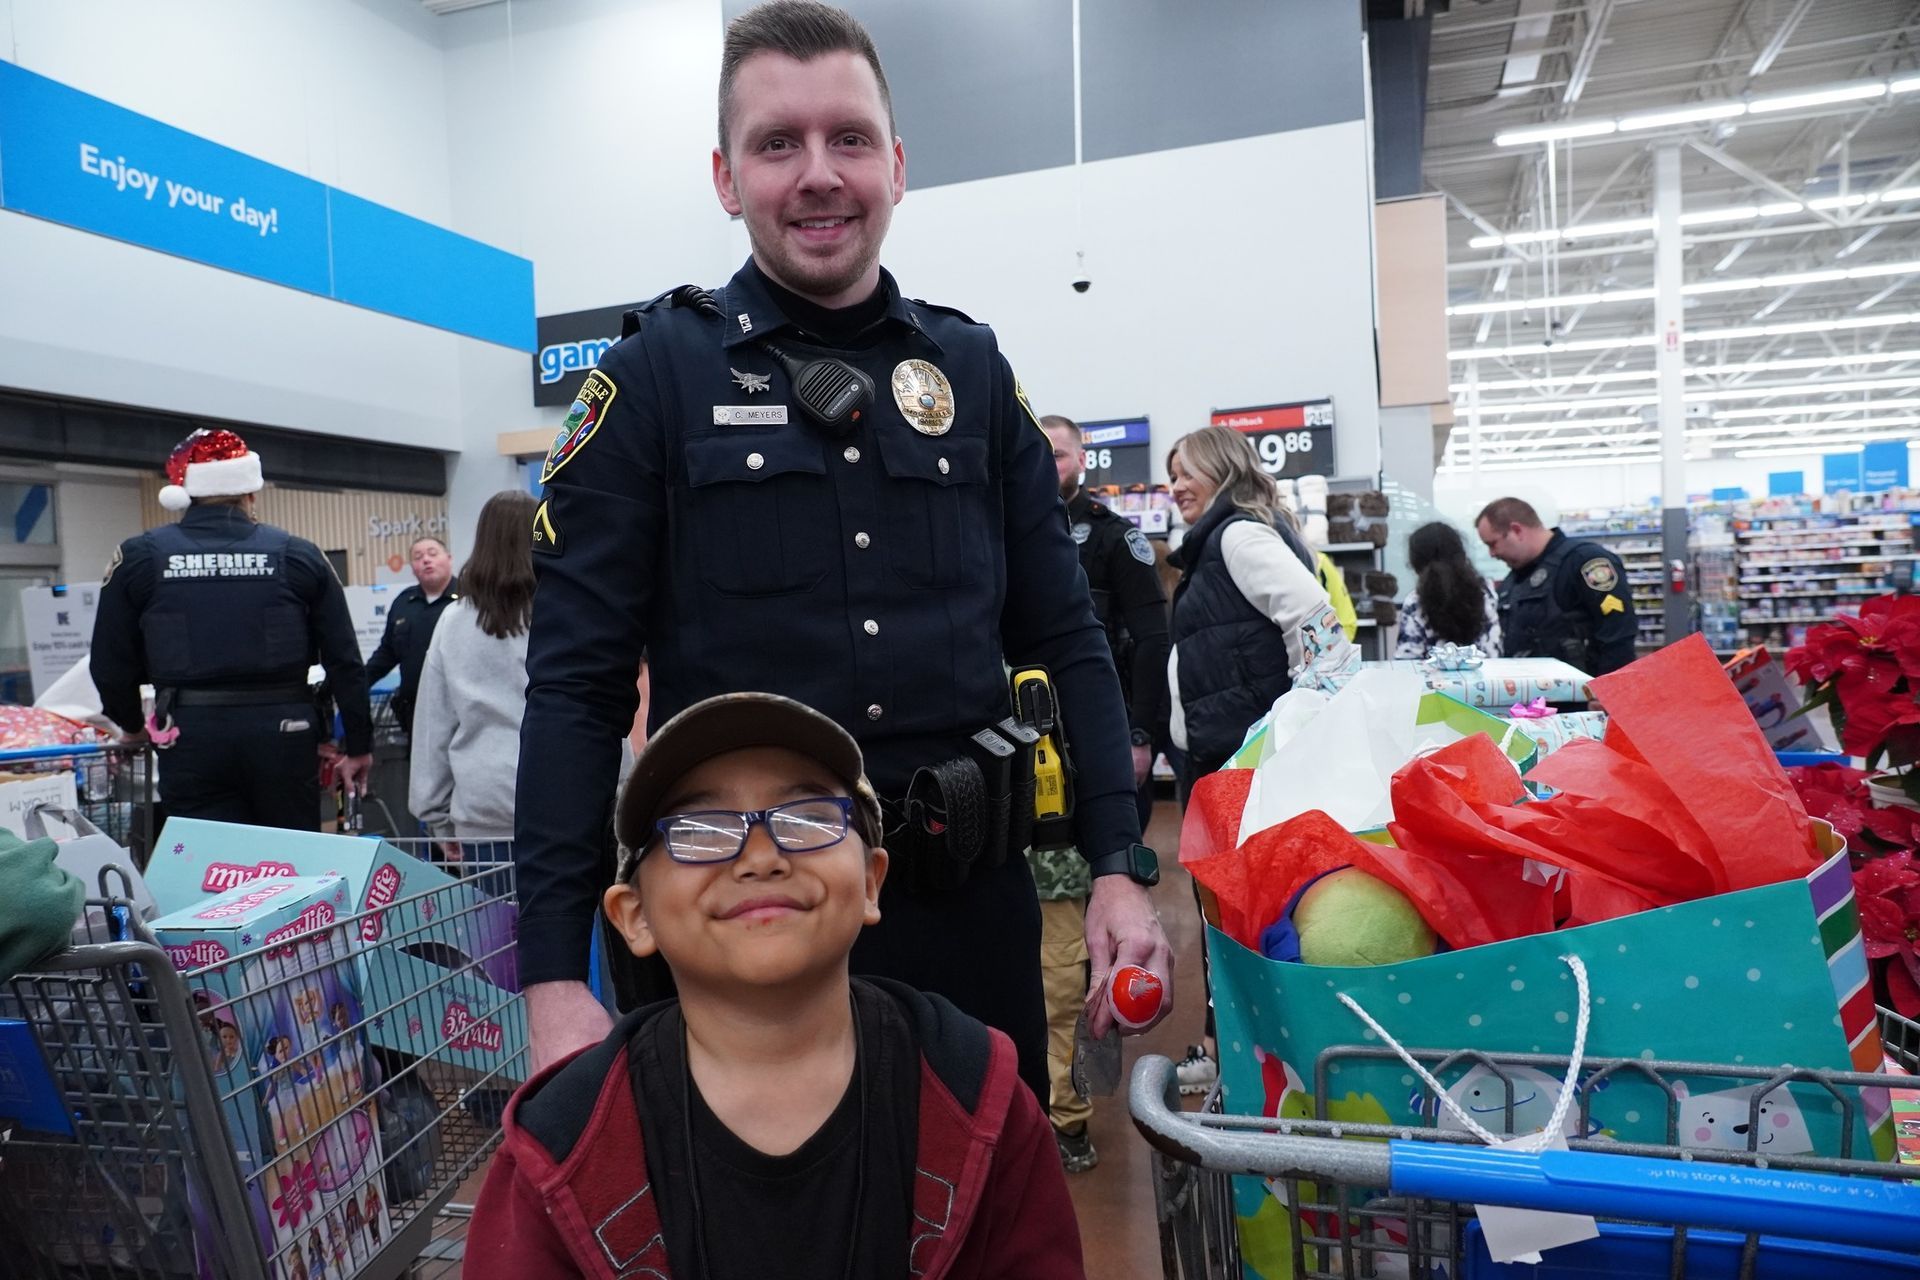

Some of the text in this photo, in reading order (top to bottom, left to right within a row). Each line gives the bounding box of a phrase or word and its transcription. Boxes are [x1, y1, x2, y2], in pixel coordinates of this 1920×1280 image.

[80, 143, 278, 237] Enjoy your day!
[540, 337, 622, 384] gam
[735, 411, 783, 419] C. MEYERS
[1285, 431, 1313, 453] 86
[369, 513, 422, 543] Spark
[168, 553, 268, 570] SHERIFF
[163, 567, 275, 578] BLOUNT COUNTY
[1691, 1171, 1727, 1184] store
[1744, 1177, 1781, 1188] more
[1784, 1180, 1815, 1191] with
